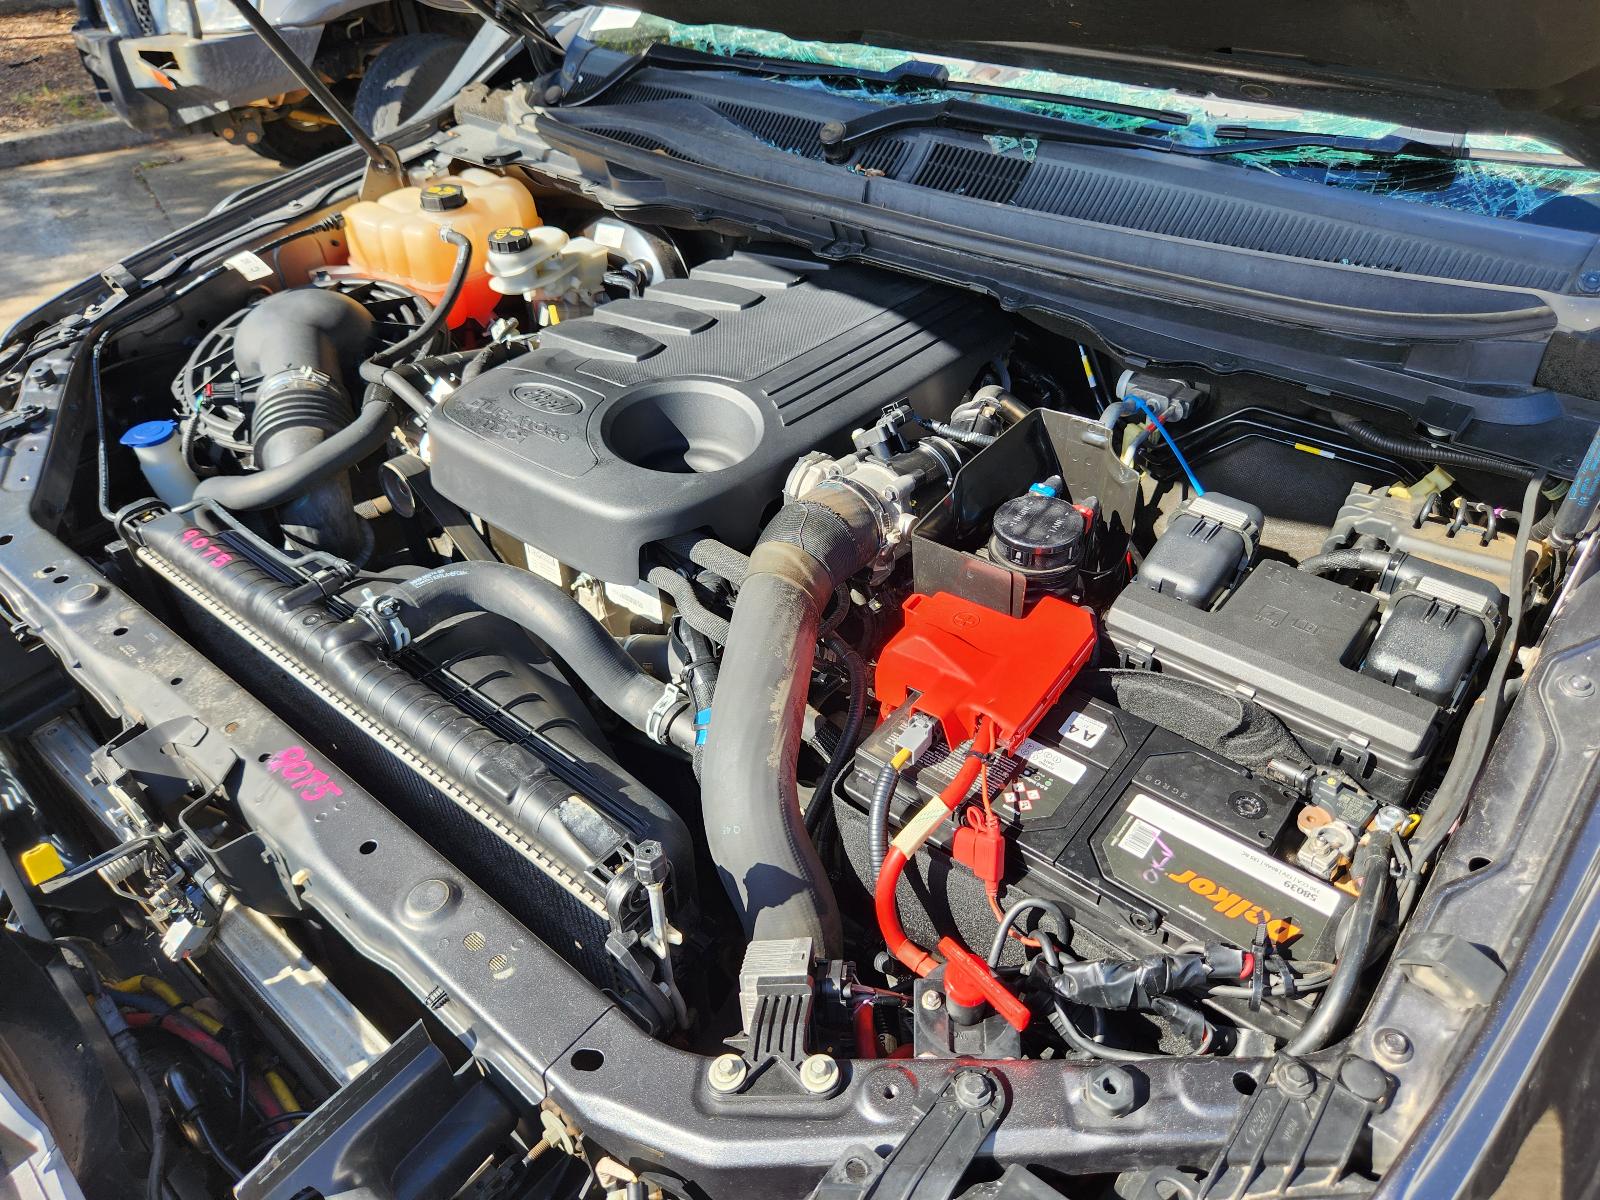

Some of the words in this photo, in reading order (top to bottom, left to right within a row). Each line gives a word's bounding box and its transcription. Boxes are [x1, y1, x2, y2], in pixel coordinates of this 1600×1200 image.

[517, 387, 580, 414] Ford
[1283, 880, 1318, 902] 58039
[1168, 869, 1302, 944] Delkor
